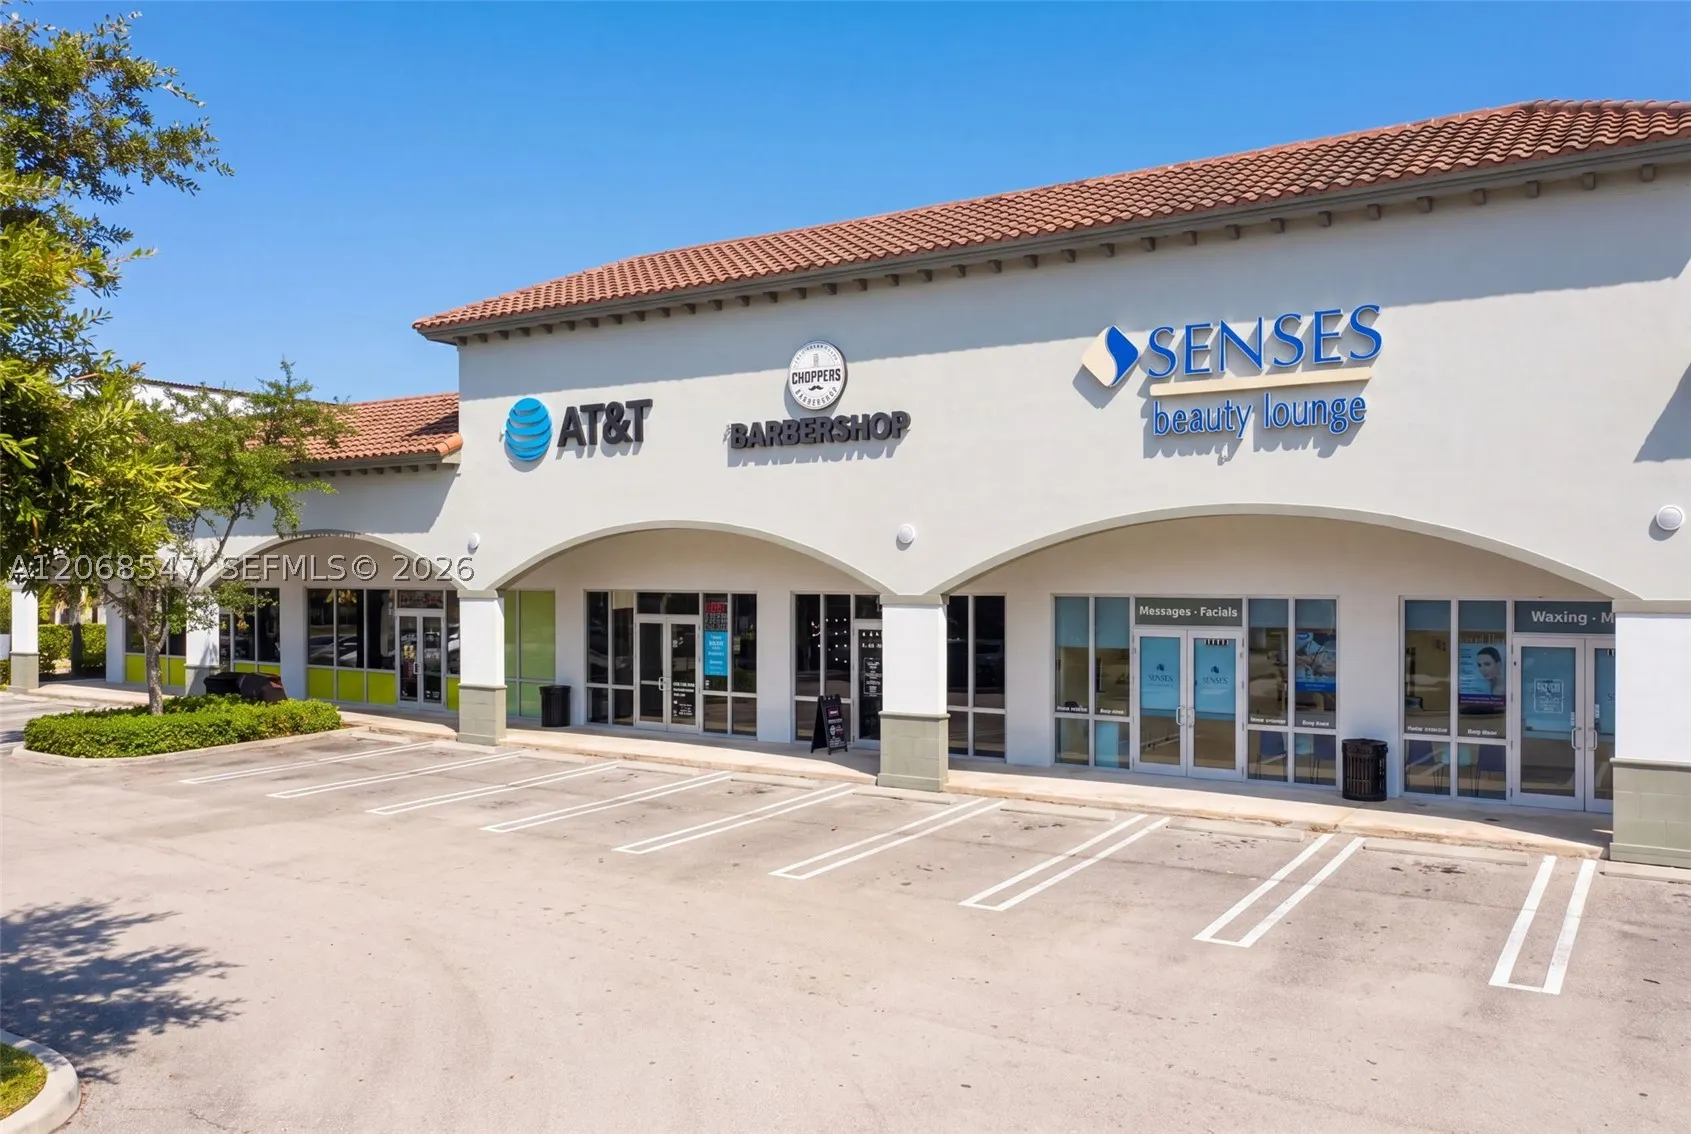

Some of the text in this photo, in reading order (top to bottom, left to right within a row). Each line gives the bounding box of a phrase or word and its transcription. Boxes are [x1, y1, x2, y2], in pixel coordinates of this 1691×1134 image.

[1147, 304, 1382, 379] SENSES
[791, 368, 841, 385] CHOPPERS
[794, 386, 838, 406] BARBERSHOP
[557, 399, 653, 448] AT&T
[730, 411, 911, 450] BARBERSHOP
[1152, 393, 1366, 439] beauty lounge
[1139, 606, 1238, 618] Messages Facials
[1531, 610, 1588, 626] Waxing
